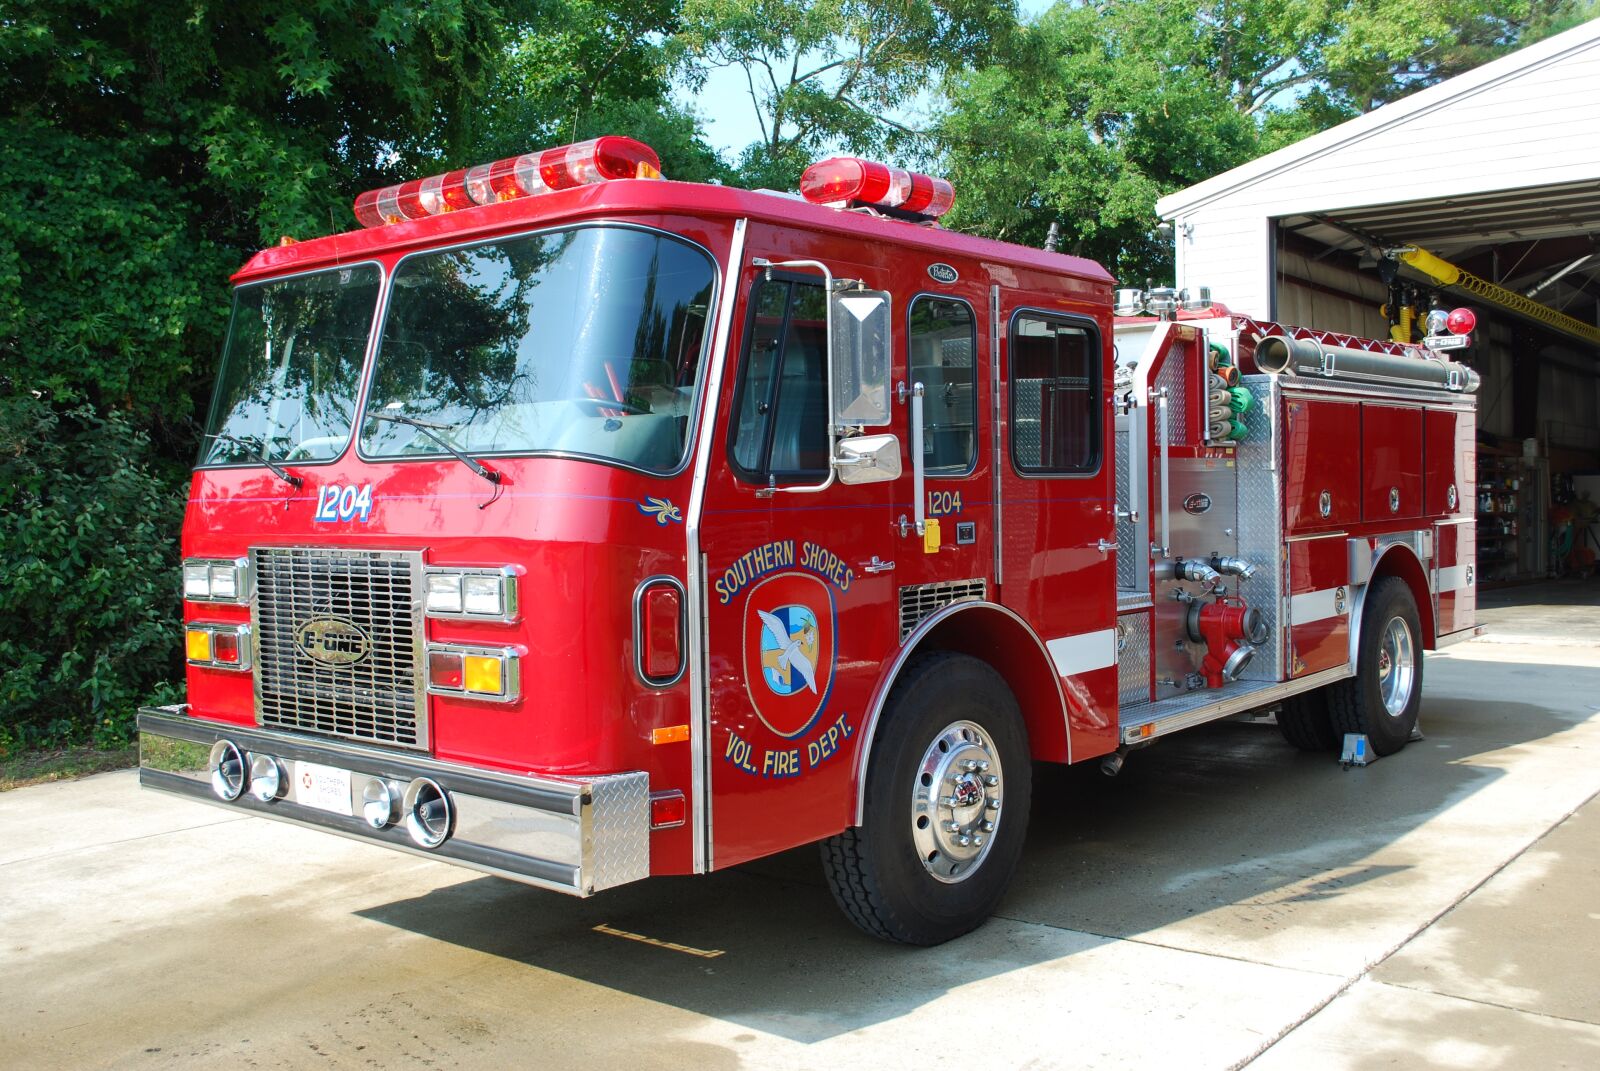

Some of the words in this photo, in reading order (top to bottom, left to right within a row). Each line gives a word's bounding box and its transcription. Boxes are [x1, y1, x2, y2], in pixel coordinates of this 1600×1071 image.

[315, 484, 373, 522] 1204
[928, 490, 963, 516] 1204
[714, 540, 796, 605] SOUTHERN
[800, 541, 854, 592] SHORES
[303, 631, 363, 653] E-ONE
[725, 732, 758, 774] VOL.
[763, 749, 801, 777] FIRE
[807, 713, 853, 767] DEPT.
